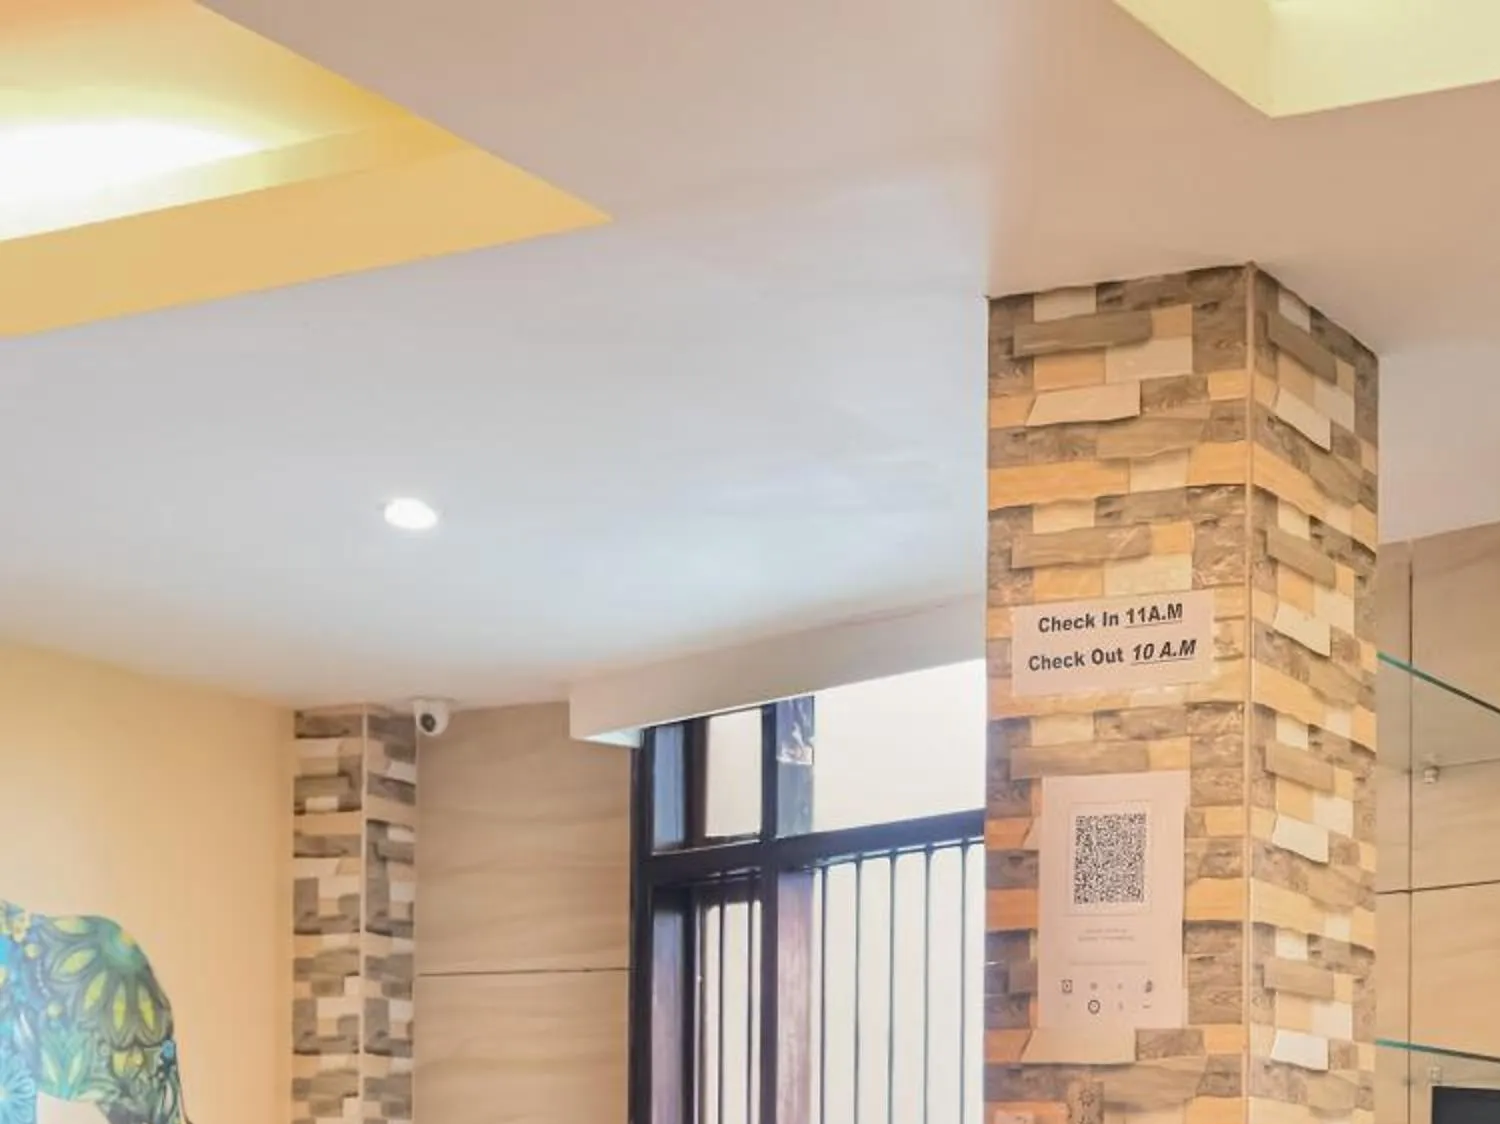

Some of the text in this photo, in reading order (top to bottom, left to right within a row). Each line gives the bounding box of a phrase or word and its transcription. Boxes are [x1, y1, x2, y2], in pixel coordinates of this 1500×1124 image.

[1038, 603, 1184, 633] Check In 11A.M
[1028, 639, 1198, 671] Check Out 10 A.M
